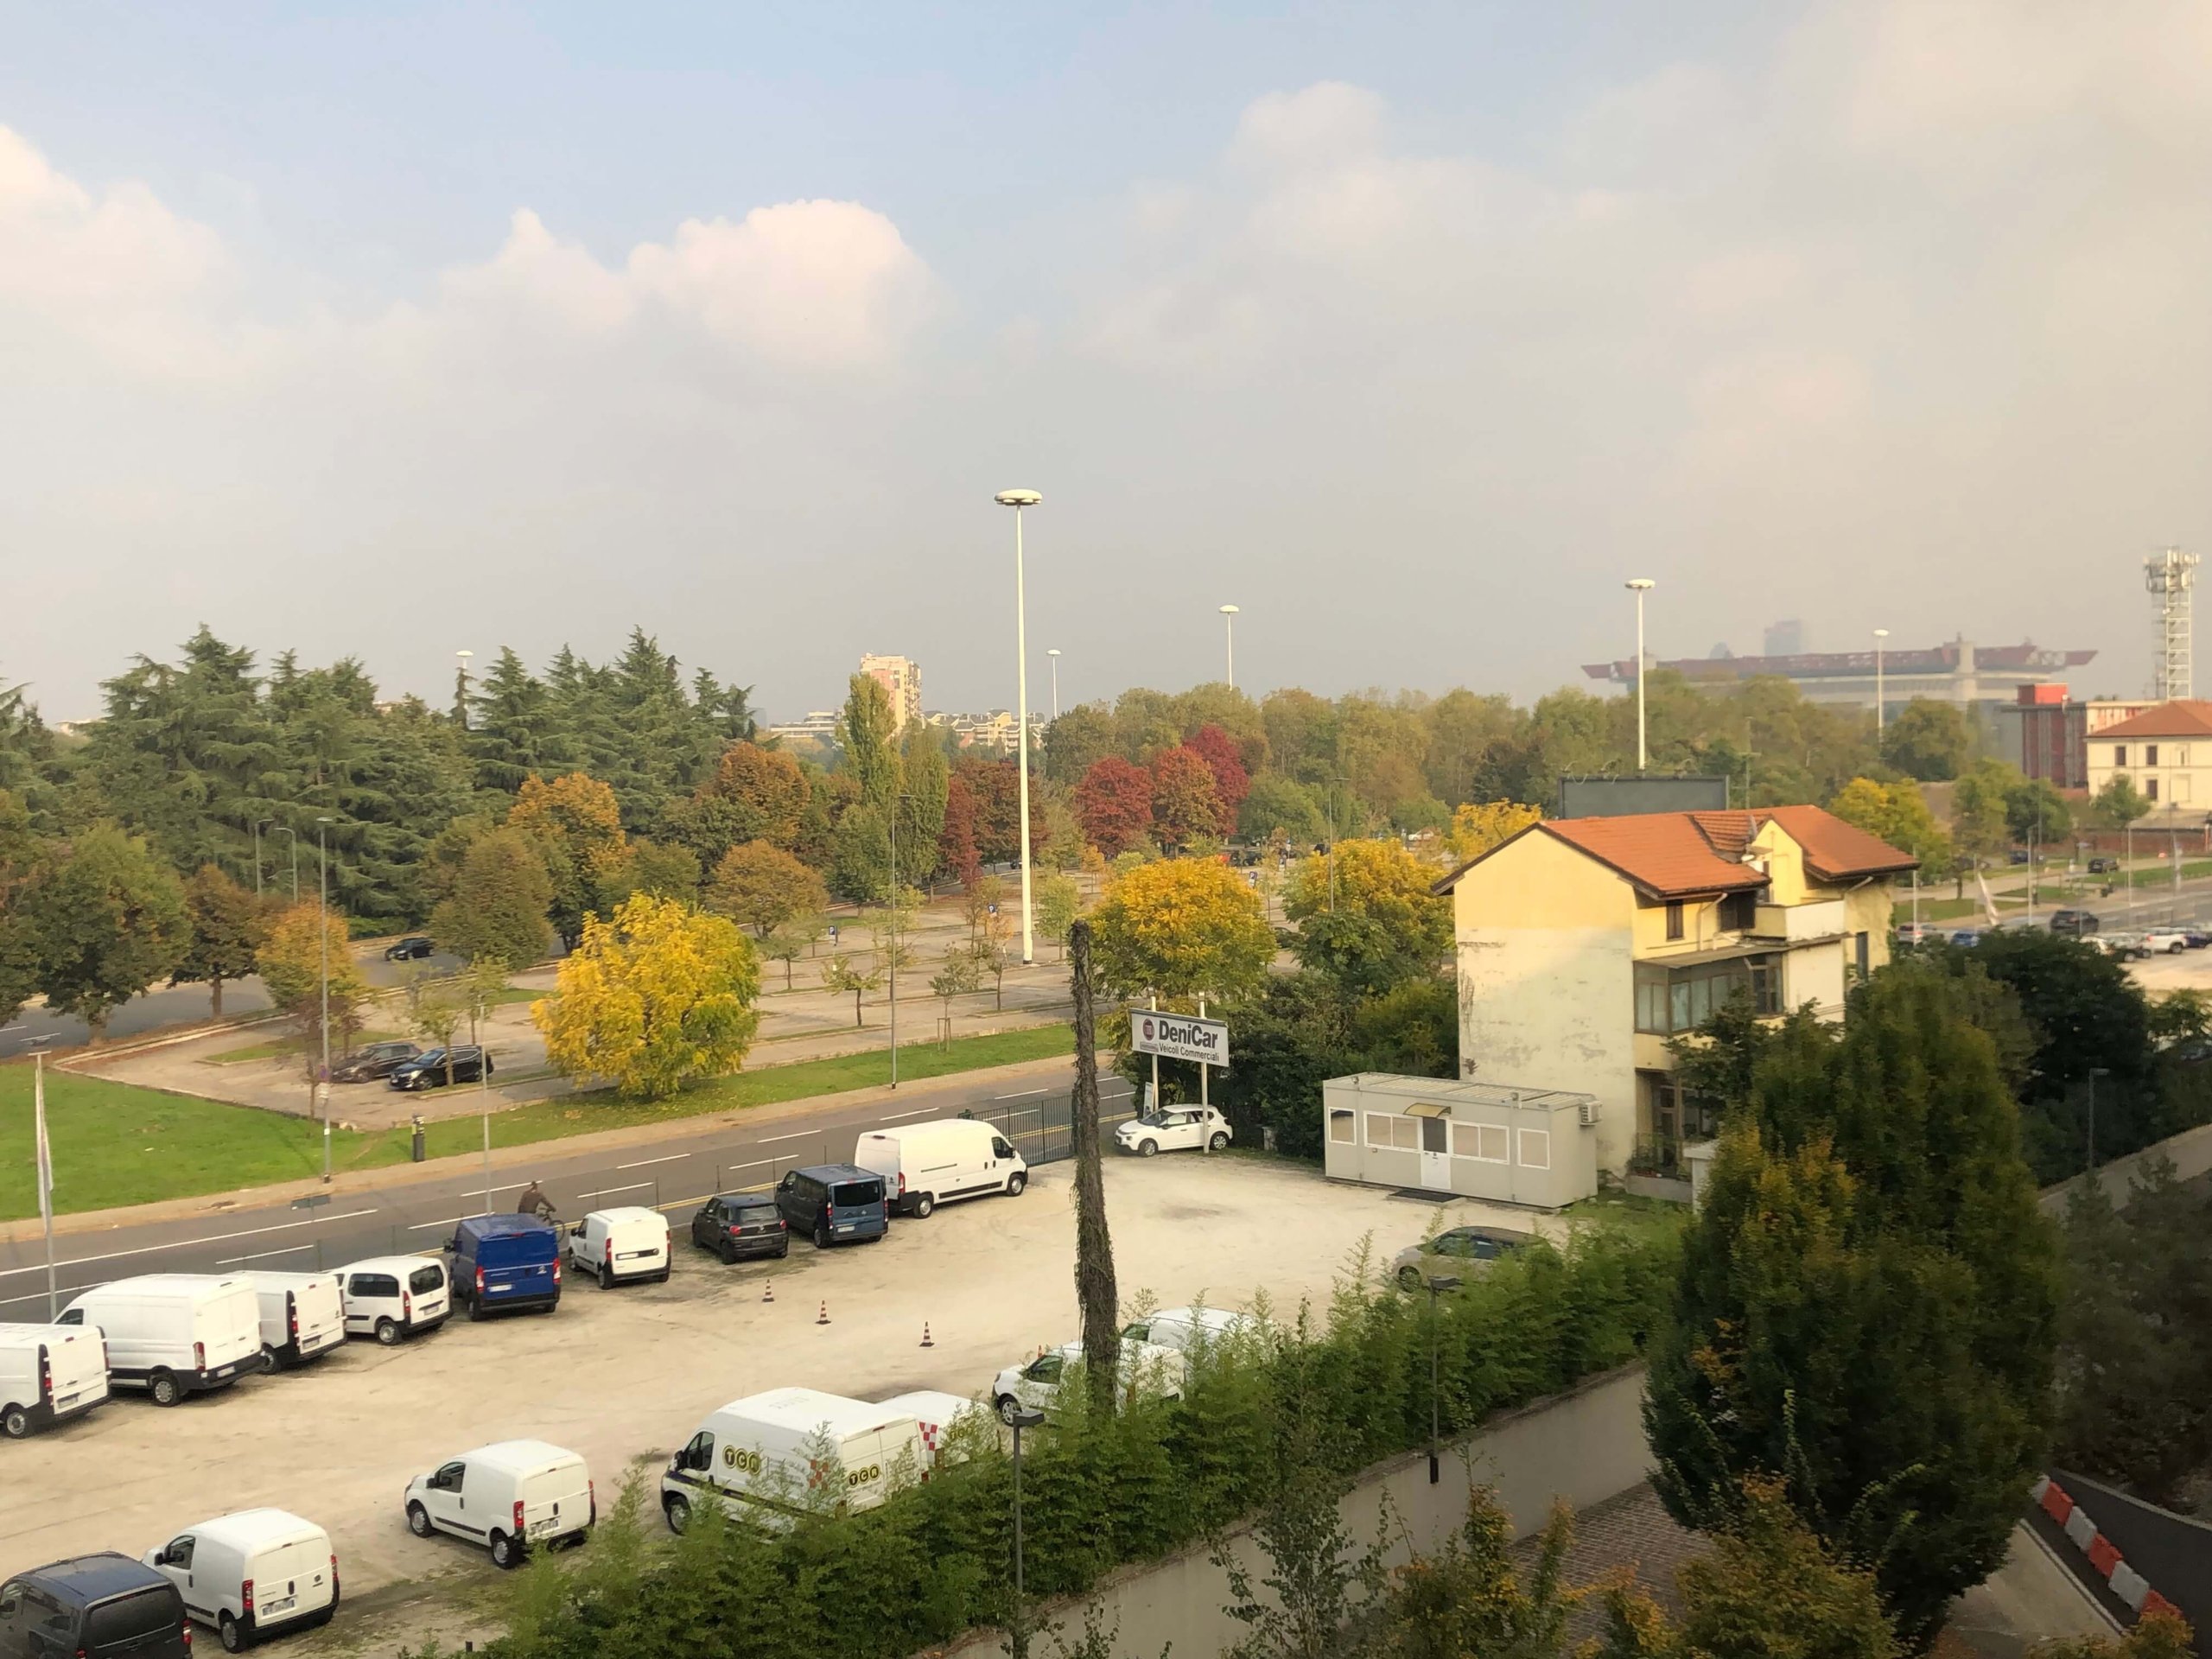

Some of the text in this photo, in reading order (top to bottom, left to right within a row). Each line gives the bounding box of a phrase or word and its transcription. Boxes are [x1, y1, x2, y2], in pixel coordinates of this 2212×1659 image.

[1159, 1020, 1218, 1049] DeniCar
[1159, 1043, 1179, 1054] Veicoli
[1180, 1046, 1219, 1062] Commerciali
